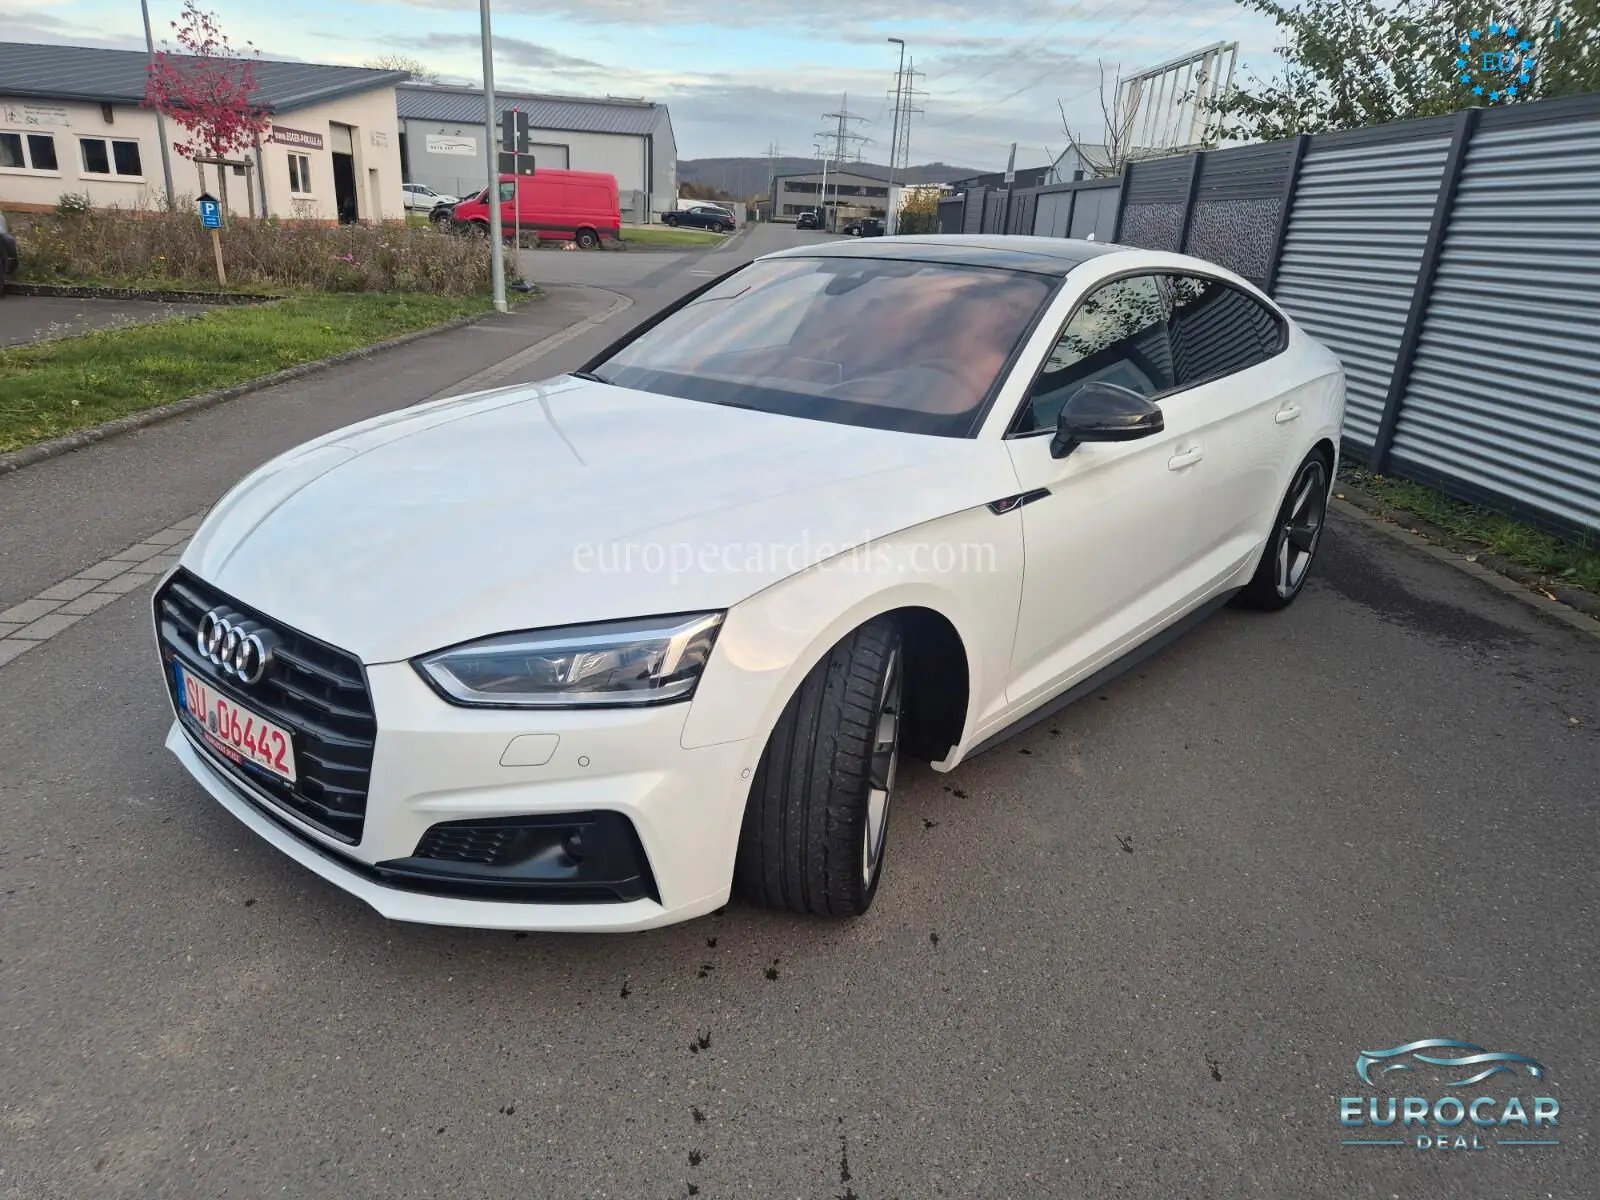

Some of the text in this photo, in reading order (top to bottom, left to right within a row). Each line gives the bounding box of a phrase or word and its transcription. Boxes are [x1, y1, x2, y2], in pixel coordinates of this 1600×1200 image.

[206, 203, 214, 215] P
[186, 677, 207, 724] SU
[217, 699, 289, 774] 06442
